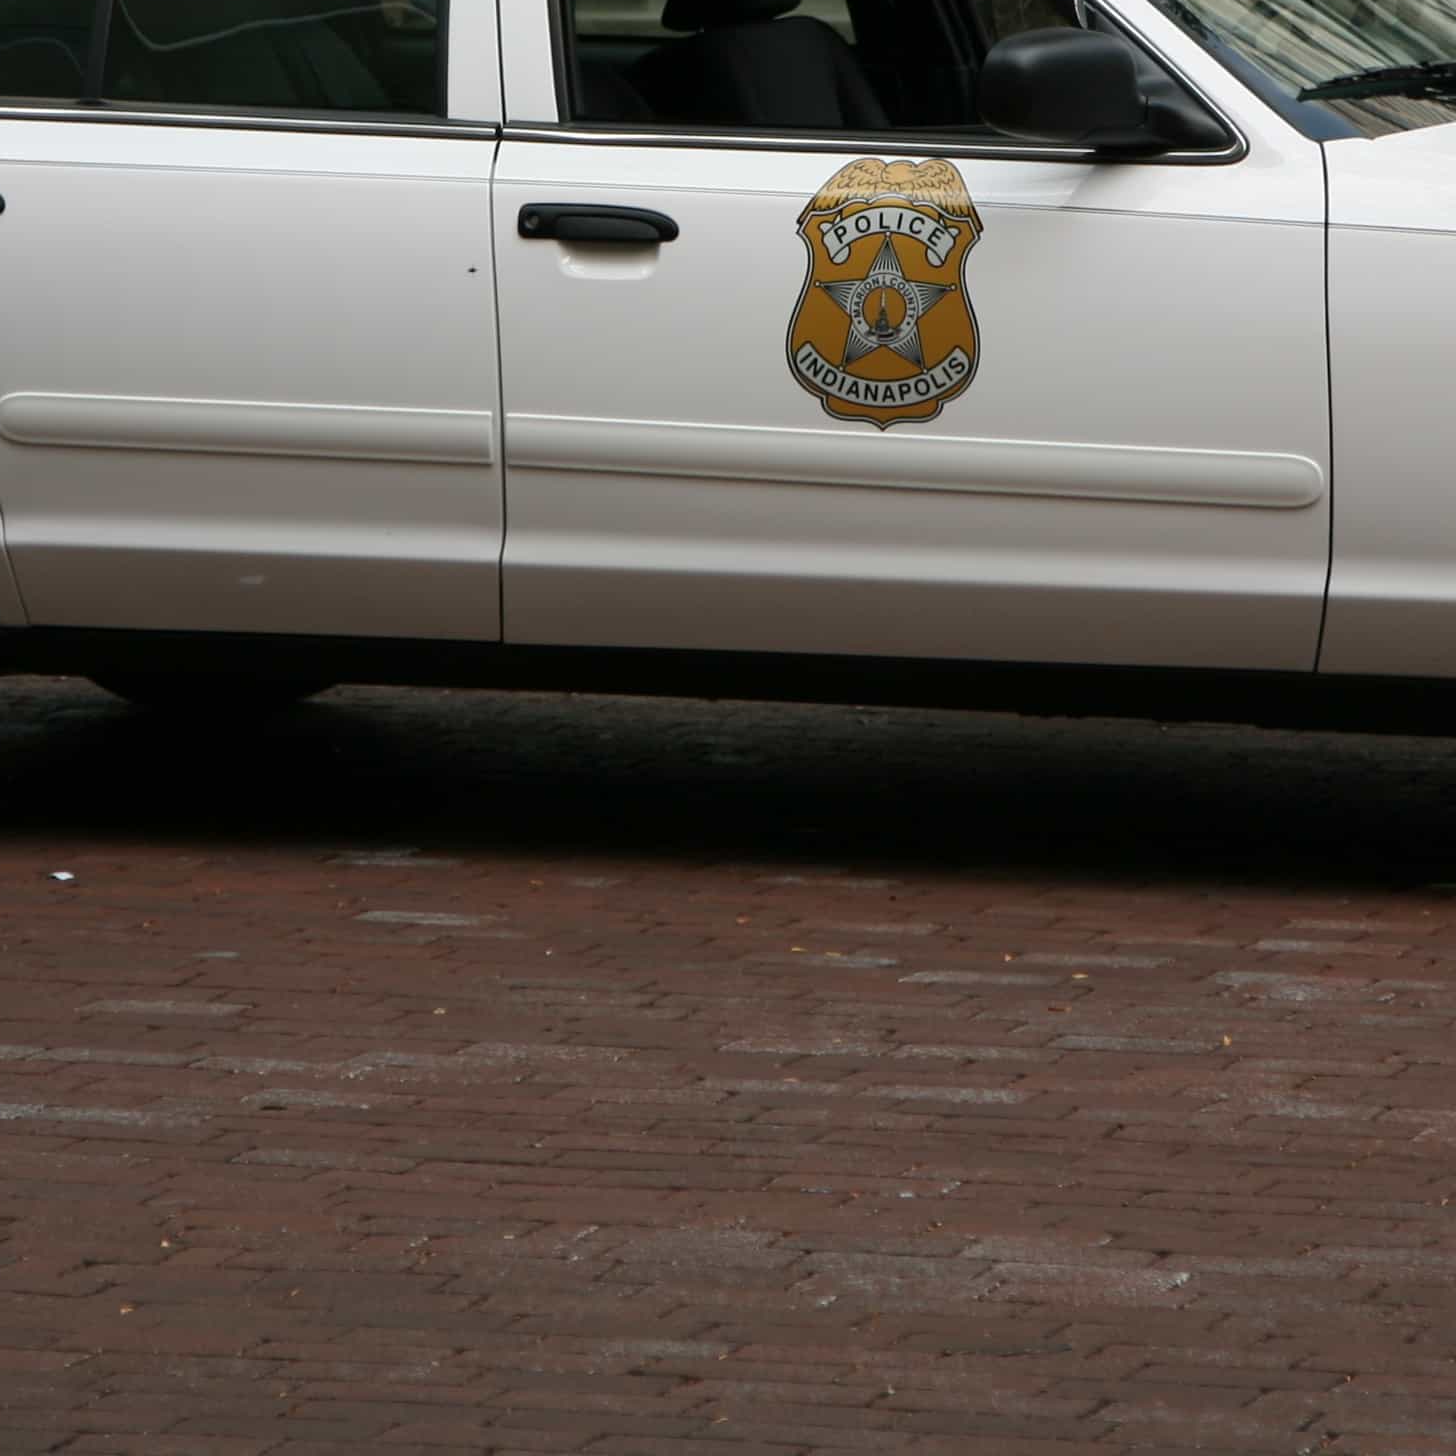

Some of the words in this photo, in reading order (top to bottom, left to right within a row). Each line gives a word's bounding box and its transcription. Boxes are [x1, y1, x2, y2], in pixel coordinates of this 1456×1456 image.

[834, 212, 945, 246] POLICE
[853, 277, 880, 318] MARION
[889, 277, 917, 320] COUNTY
[799, 351, 966, 402] INDIANAPOLIS
